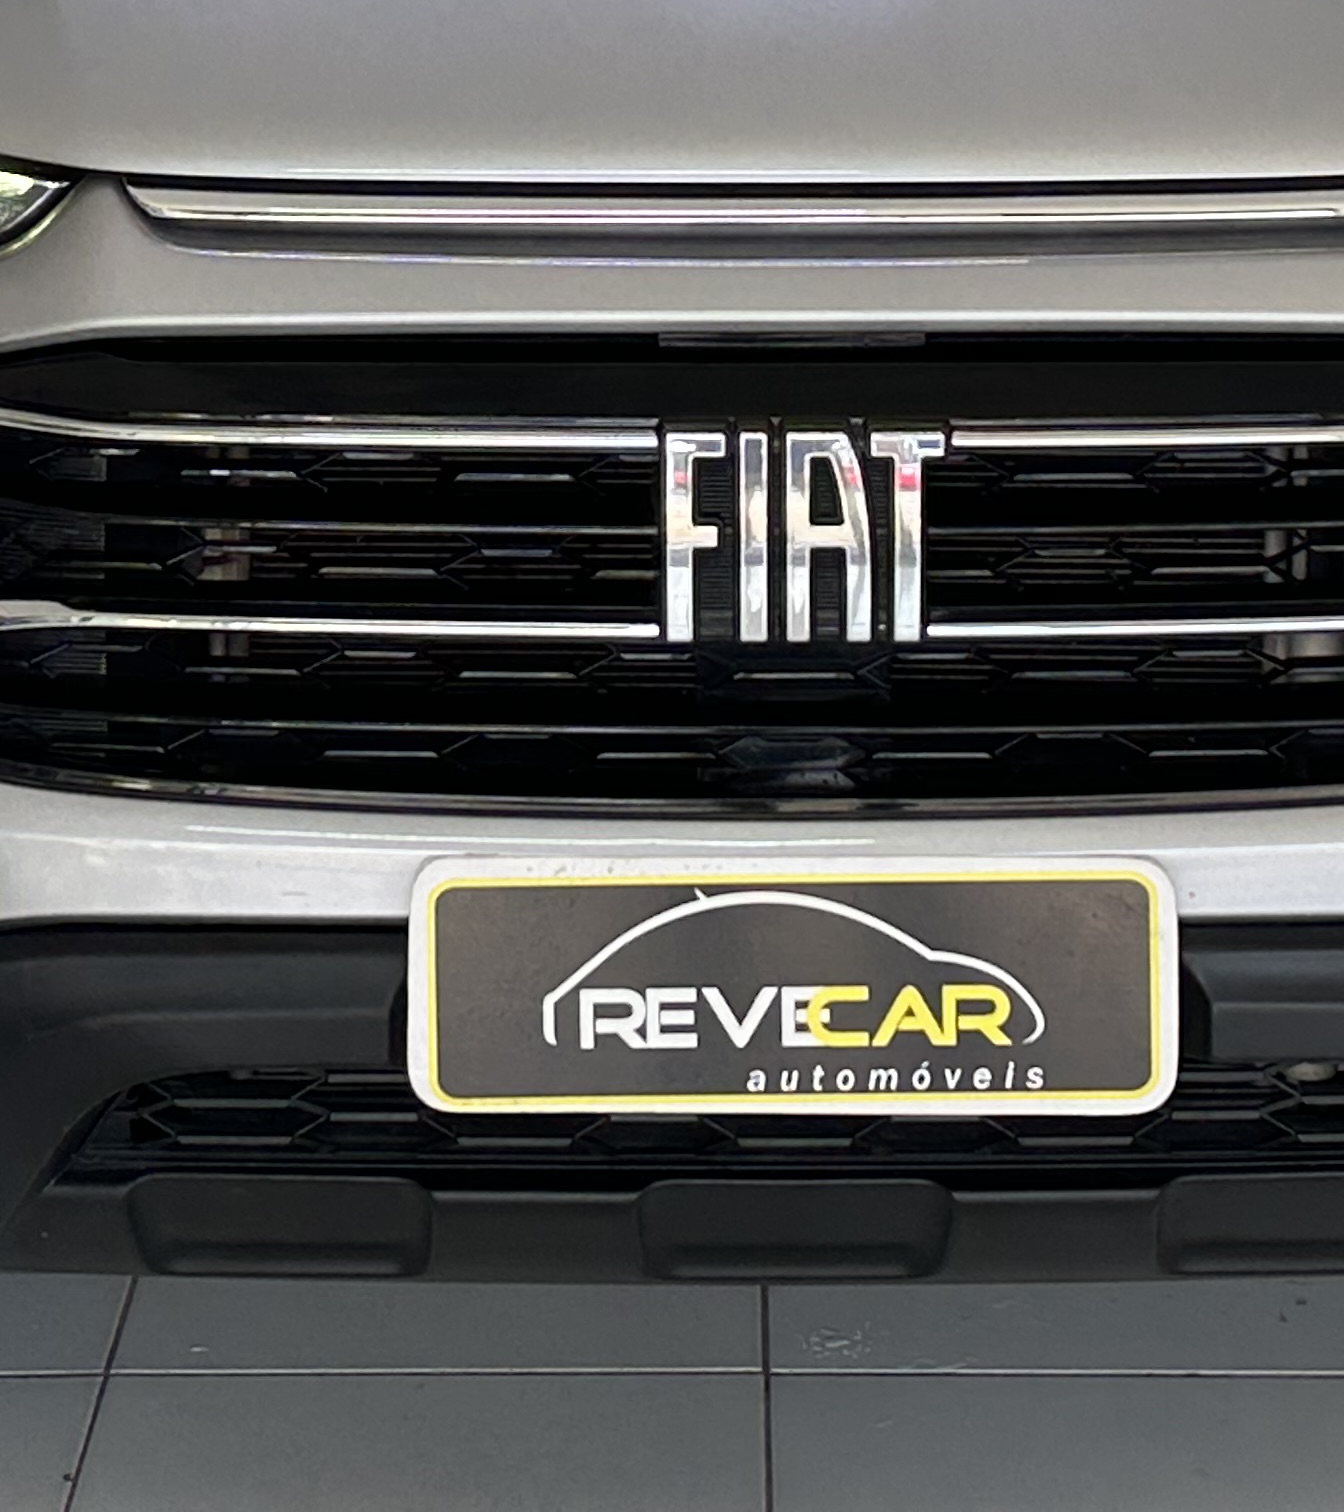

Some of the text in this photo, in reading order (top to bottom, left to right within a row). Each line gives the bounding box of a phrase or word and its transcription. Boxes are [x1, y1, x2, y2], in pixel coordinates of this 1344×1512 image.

[665, 431, 946, 642] FIAT
[578, 983, 1013, 1050] REVECAR
[746, 1060, 1045, 1093] automóveis
